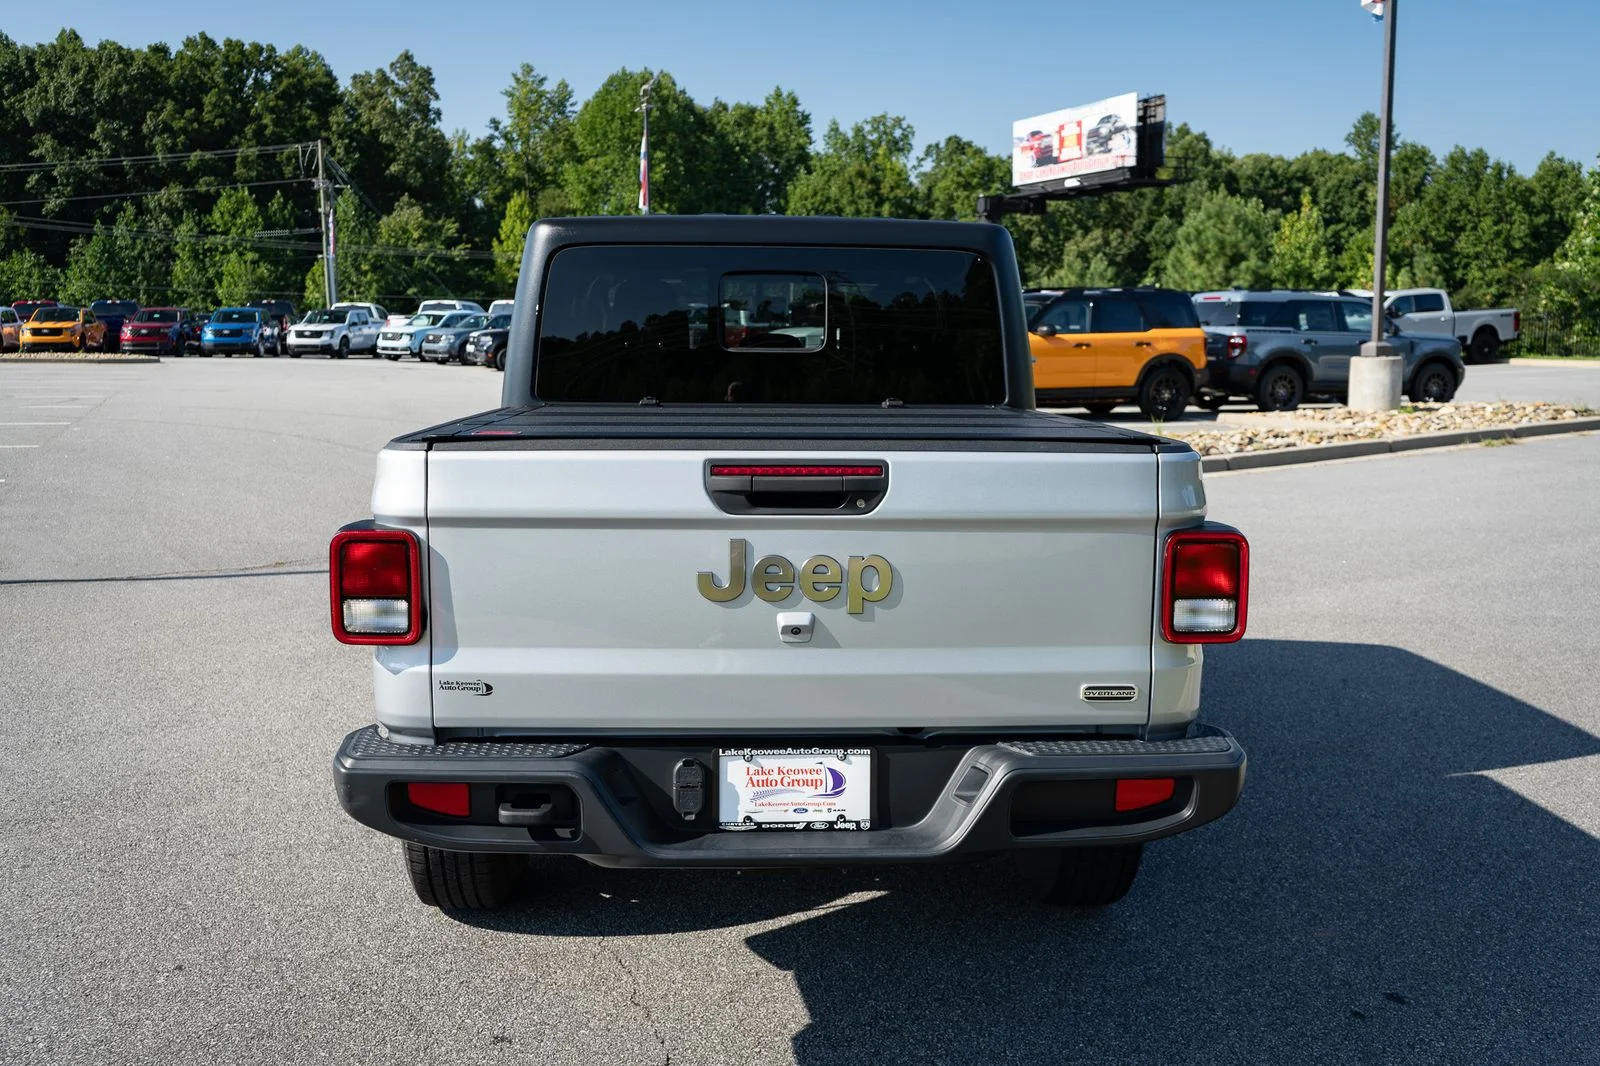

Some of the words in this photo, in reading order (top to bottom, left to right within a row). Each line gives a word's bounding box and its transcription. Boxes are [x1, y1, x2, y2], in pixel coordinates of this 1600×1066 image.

[696, 538, 894, 615] Jeep
[719, 748, 871, 756] LakeKeoweeAutoGroup.com
[746, 766, 774, 776] Lake
[777, 766, 822, 776] Keowee
[745, 777, 778, 788] Auto
[780, 776, 823, 790] Group
[833, 821, 857, 830] Jeep
